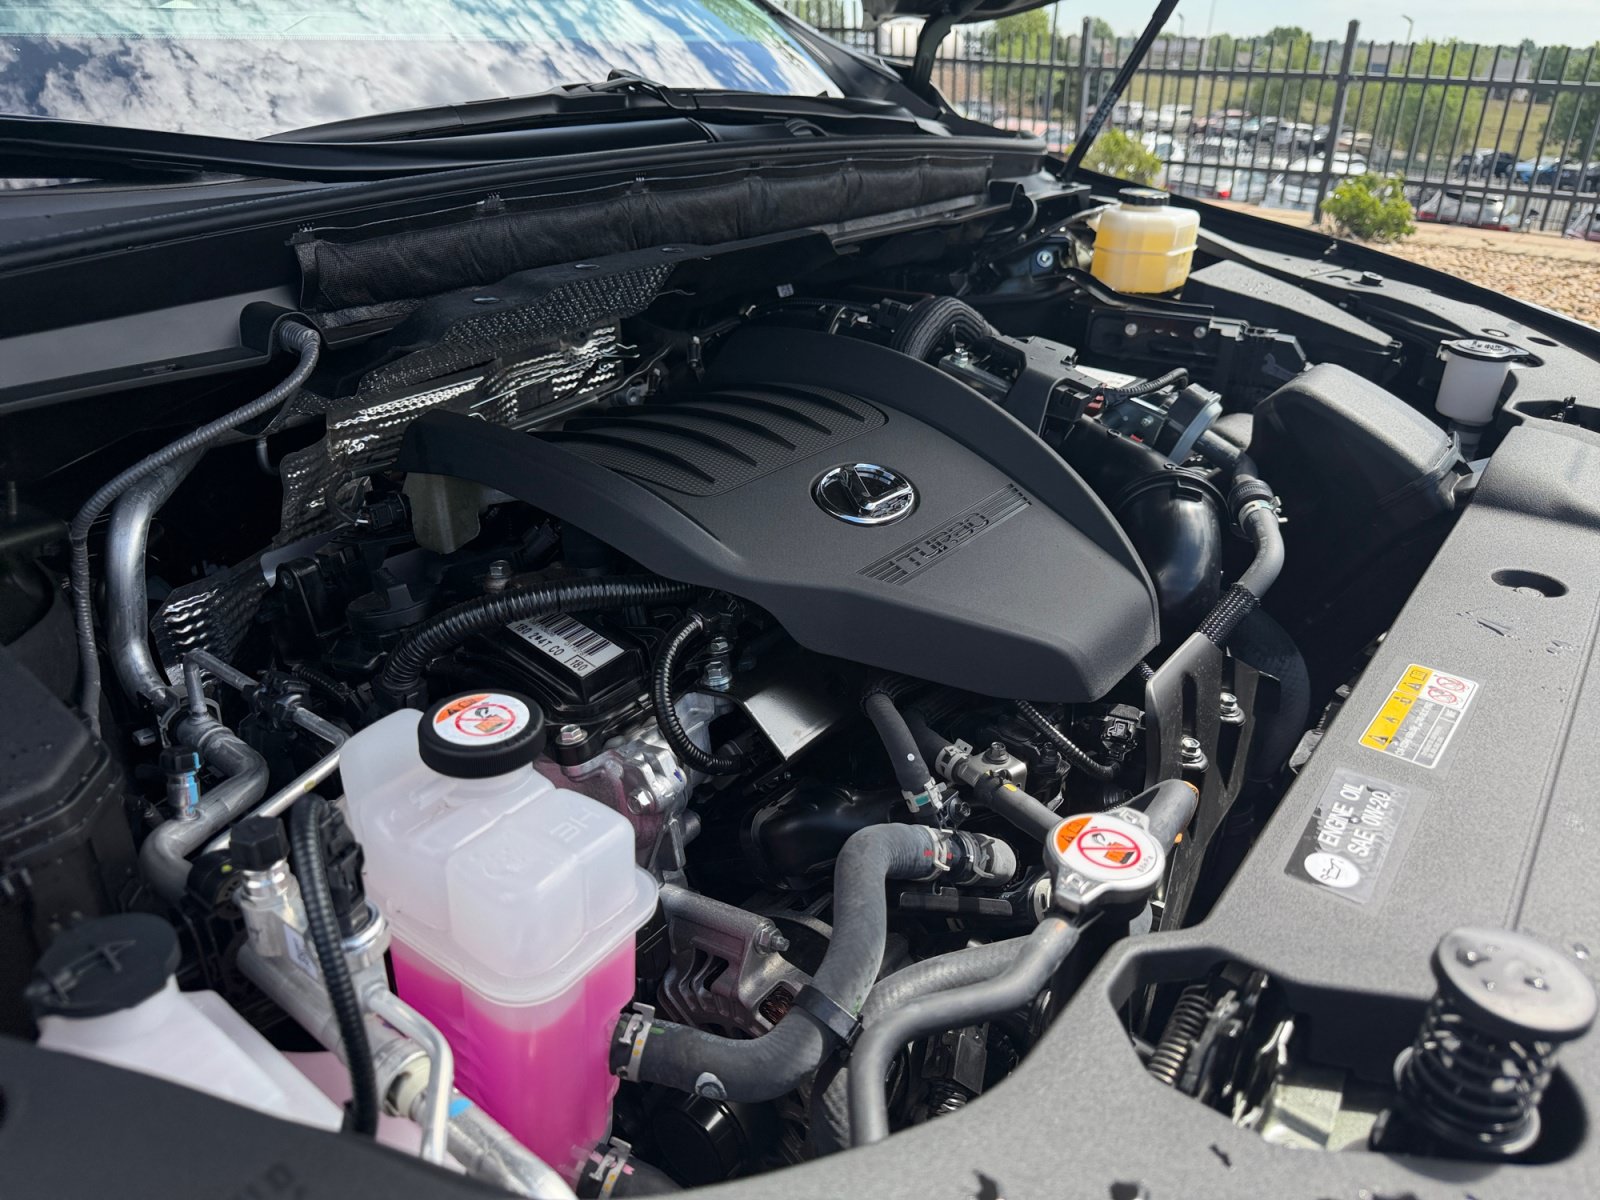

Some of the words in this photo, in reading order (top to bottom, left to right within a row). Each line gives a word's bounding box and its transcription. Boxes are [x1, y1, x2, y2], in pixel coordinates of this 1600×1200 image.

[894, 512, 989, 572] TURBO
[570, 659, 588, 671] 180
[1318, 801, 1354, 847] ENGINE
[1340, 783, 1364, 801] OIL
[1361, 790, 1391, 826] 0W-20
[1347, 828, 1376, 857] SAE
